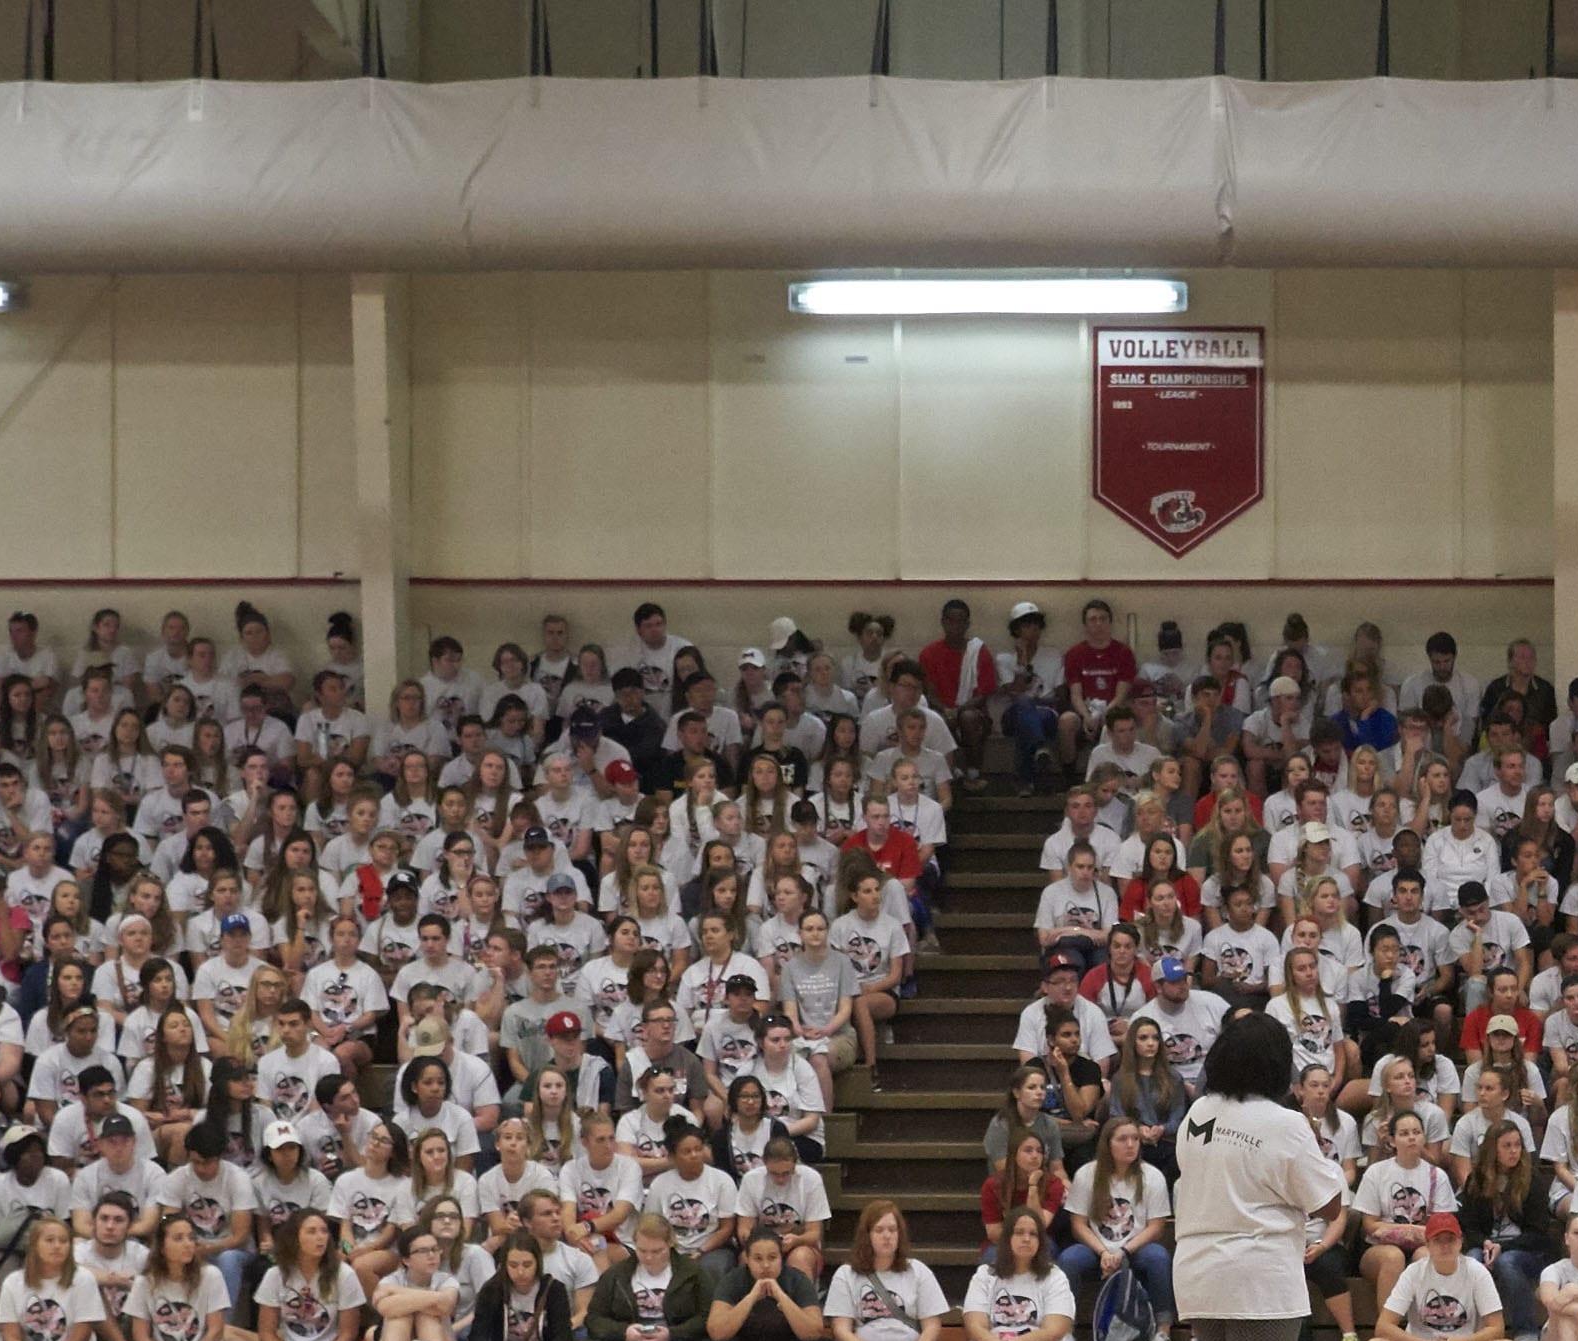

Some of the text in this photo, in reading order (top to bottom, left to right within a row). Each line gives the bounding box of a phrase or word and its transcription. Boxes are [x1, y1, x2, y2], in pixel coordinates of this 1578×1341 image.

[1109, 340, 1249, 358] VOLLEYBALL
[1110, 373, 1247, 385] SLIAC CHAMPIONSHIPS
[1160, 391, 1197, 399] LEAGUE
[1146, 443, 1212, 451] TOURNAMENT
[1216, 1126, 1263, 1149] MARYVILLE
